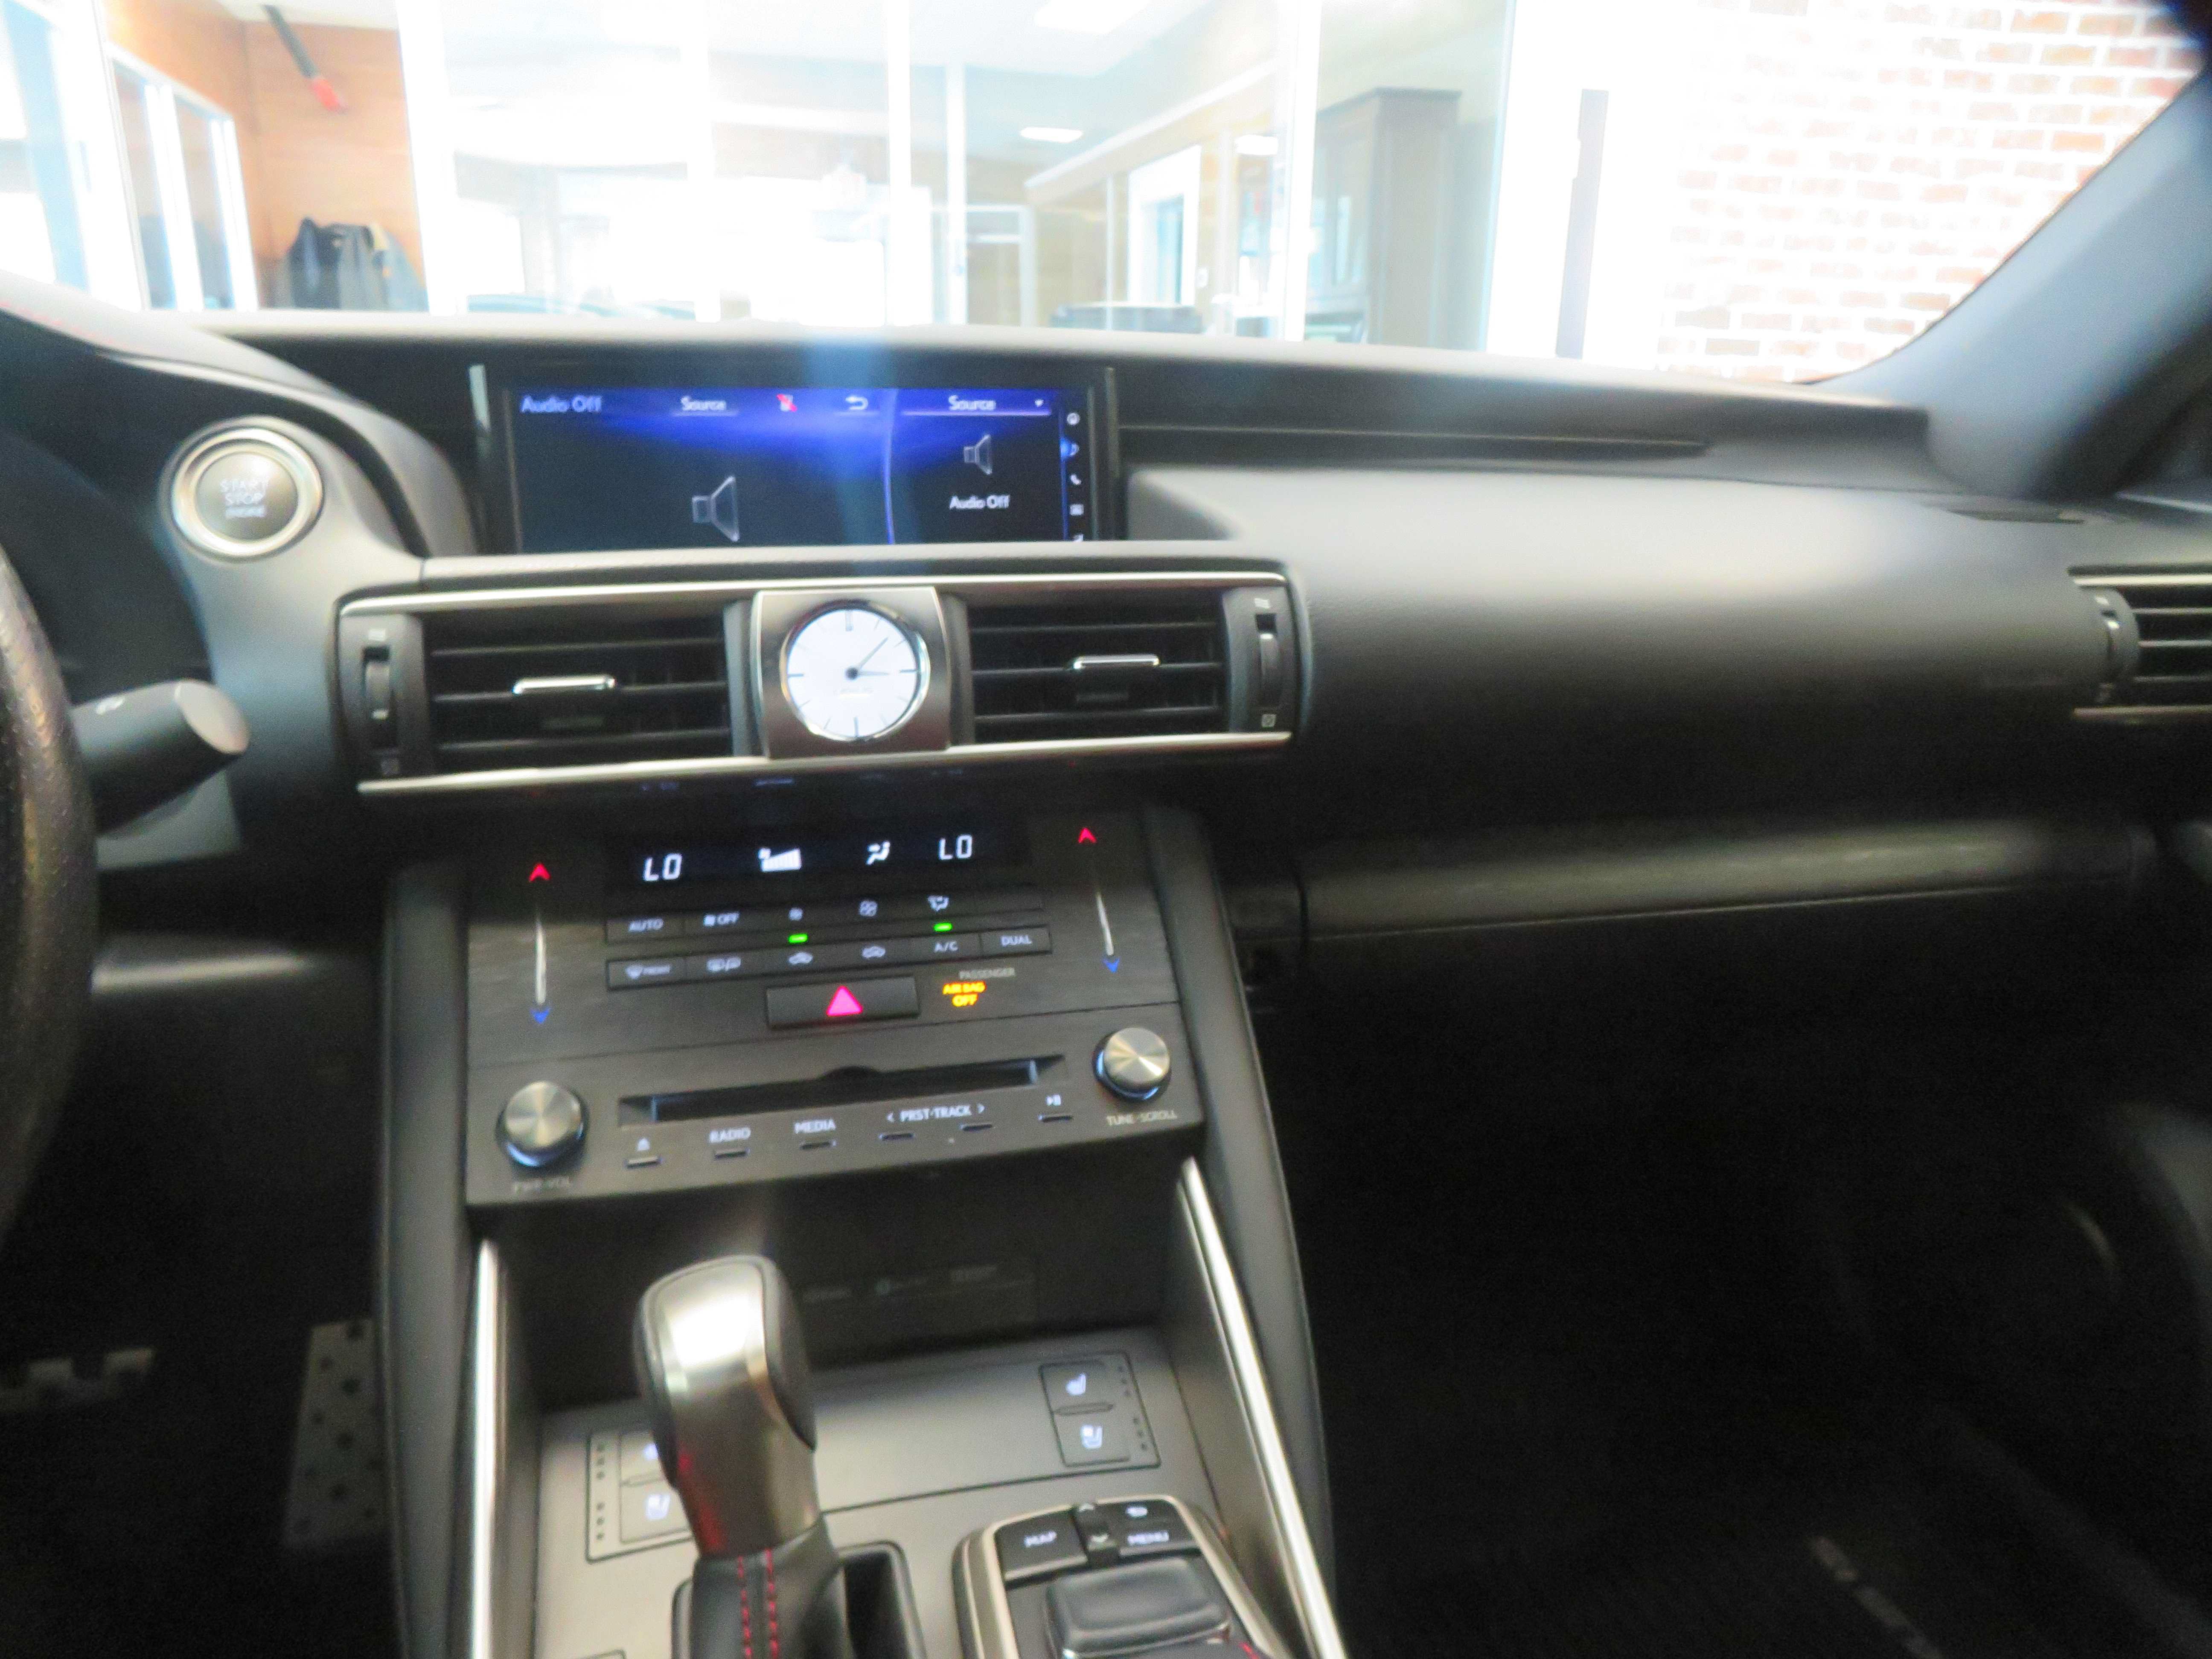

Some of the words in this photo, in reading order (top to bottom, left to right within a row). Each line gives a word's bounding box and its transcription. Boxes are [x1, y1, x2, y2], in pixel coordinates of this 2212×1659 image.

[521, 395, 568, 413] Audio
[571, 394, 602, 412] Off
[681, 395, 726, 412] Source
[948, 395, 996, 411] Source
[949, 495, 985, 510] Audio
[987, 494, 1010, 509] Off
[938, 834, 973, 861] LO
[643, 853, 683, 882] LO
[628, 917, 664, 933] AUTO
[716, 911, 740, 925] OFF
[934, 940, 958, 953] A/C
[1000, 935, 1033, 947] DUAL
[952, 993, 979, 1007] OFF
[794, 1118, 837, 1134] MEDIA
[708, 1126, 751, 1144] RADIO
